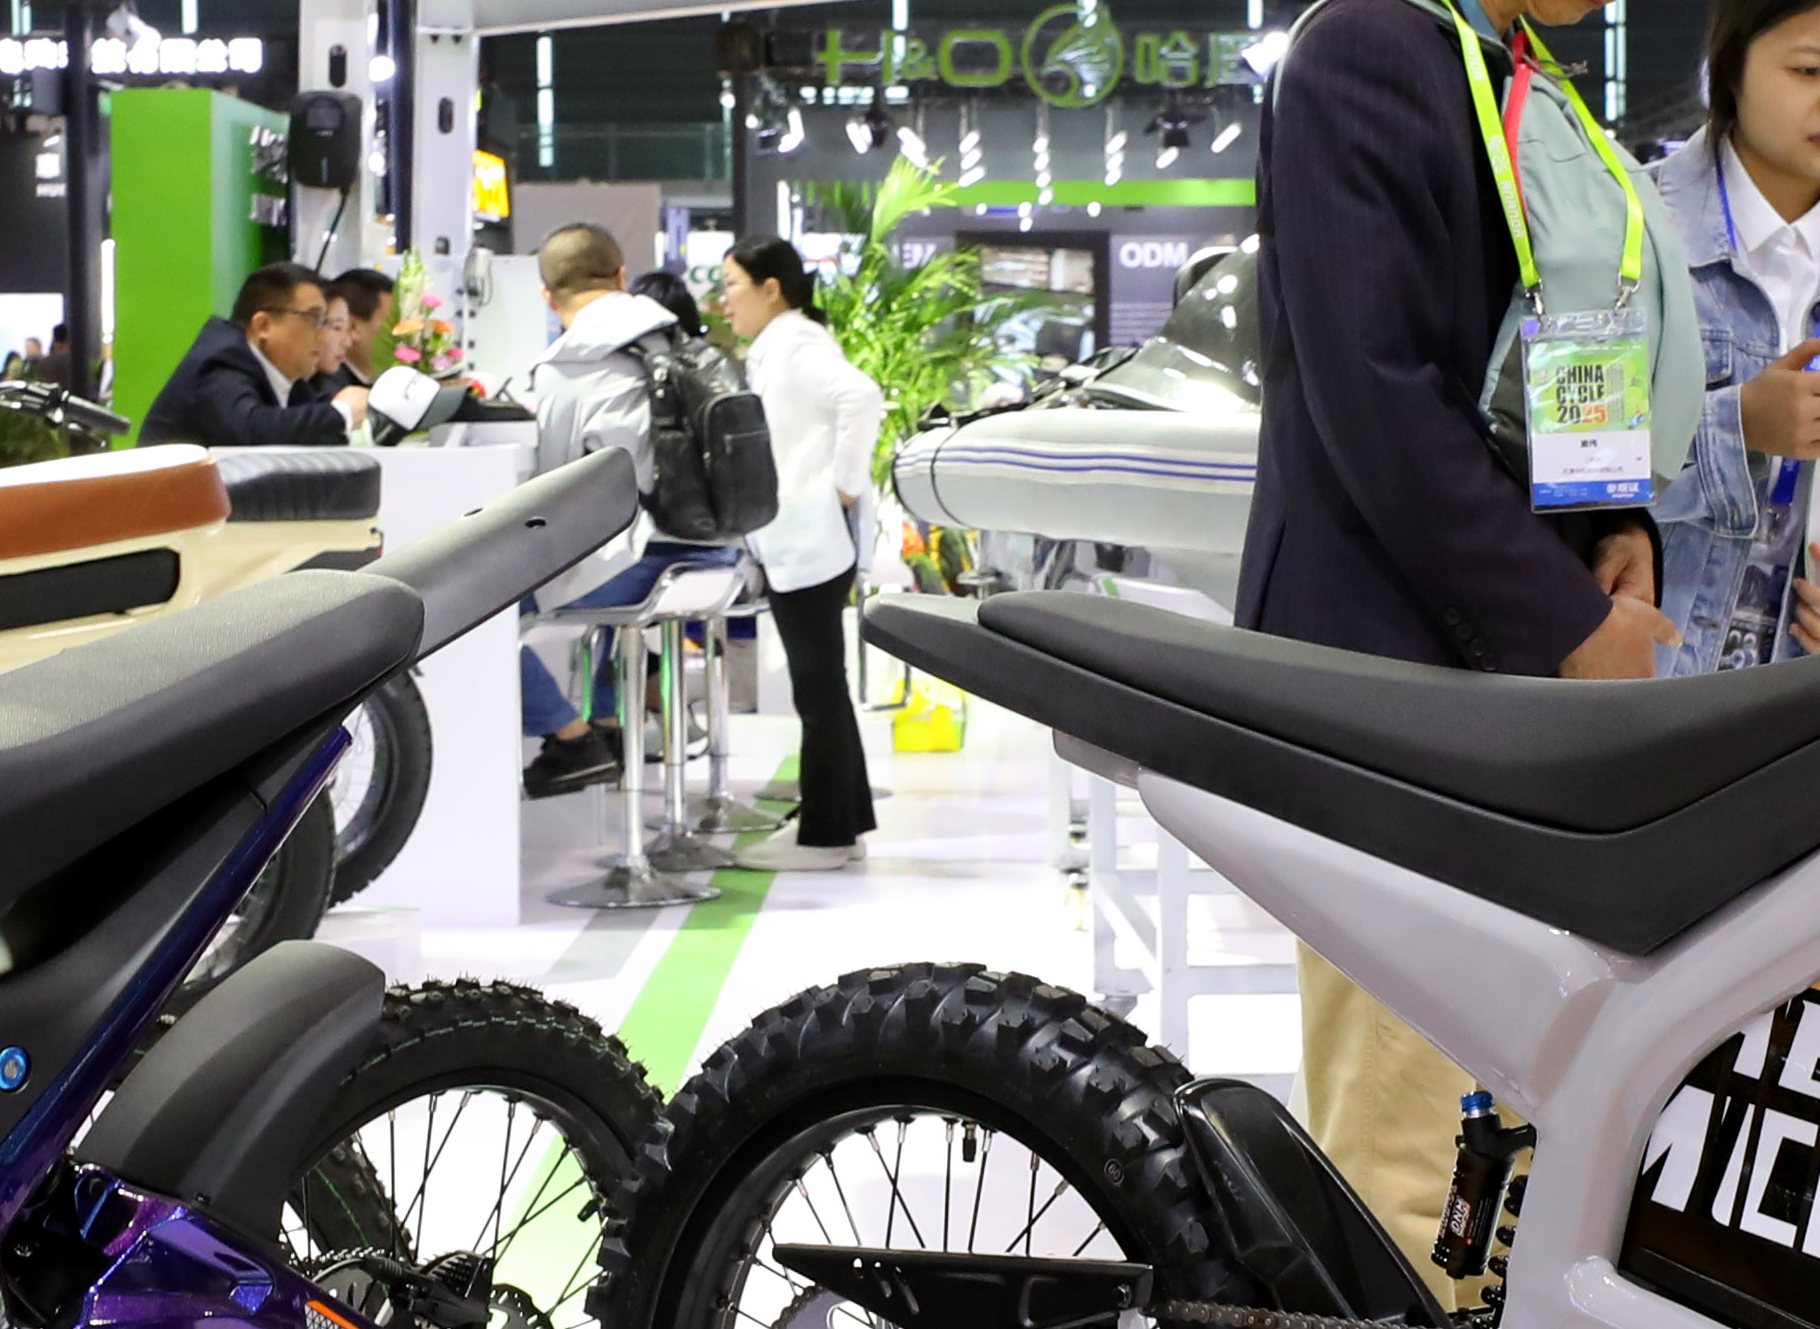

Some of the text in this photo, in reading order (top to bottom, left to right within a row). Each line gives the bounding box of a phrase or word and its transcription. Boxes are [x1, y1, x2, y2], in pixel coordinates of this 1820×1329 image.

[1119, 241, 1188, 269] ODM
[1555, 364, 1604, 385] CHINA
[1555, 384, 1605, 405] CYCLE
[1555, 403, 1608, 425] 2025
